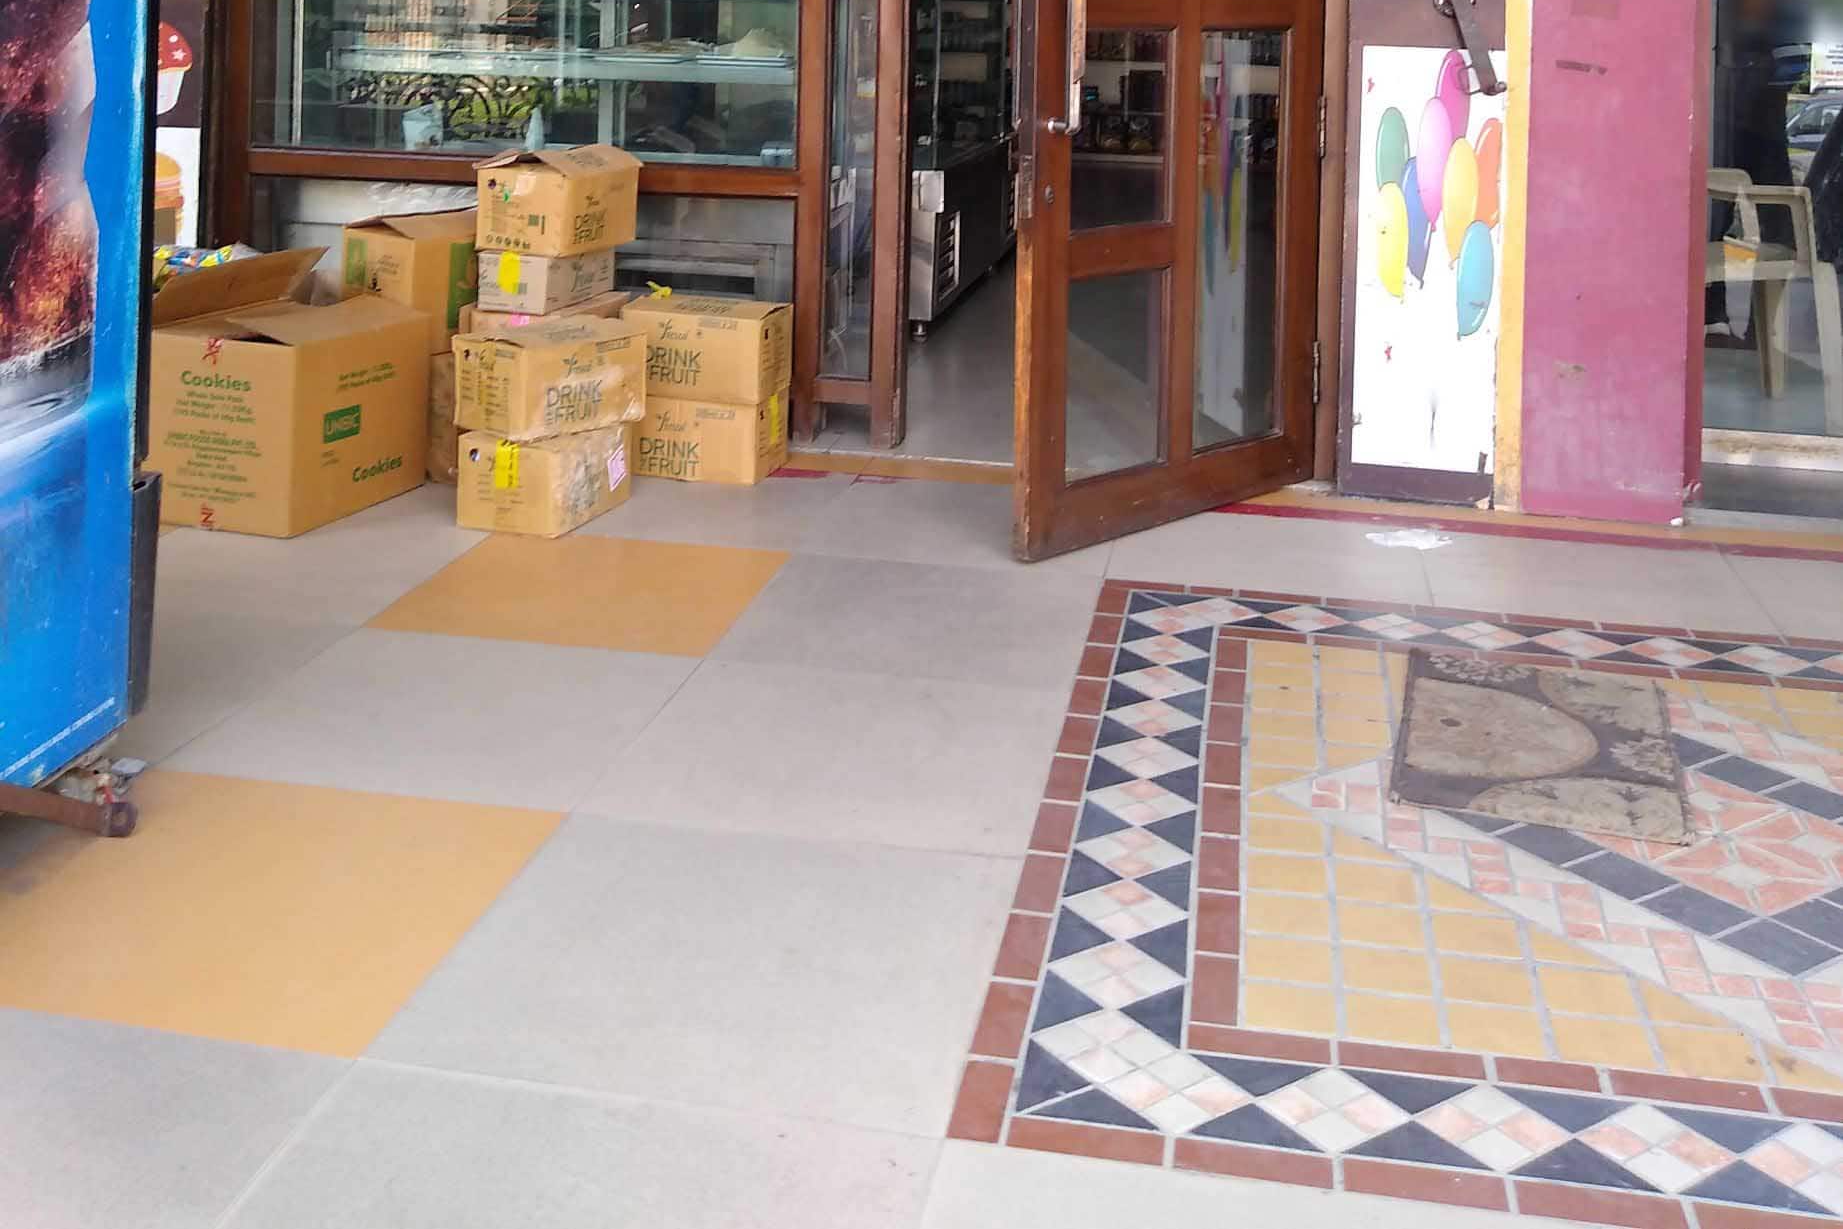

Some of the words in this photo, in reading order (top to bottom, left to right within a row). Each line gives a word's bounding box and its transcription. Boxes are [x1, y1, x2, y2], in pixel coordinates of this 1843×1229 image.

[180, 370, 253, 392] Cookies
[649, 363, 702, 386] FRUIT
[547, 380, 603, 407] DRINK
[555, 400, 602, 422] FRUIT
[639, 437, 700, 459] DRINK
[352, 455, 403, 483] Cookies
[647, 456, 700, 478] FRUIT
